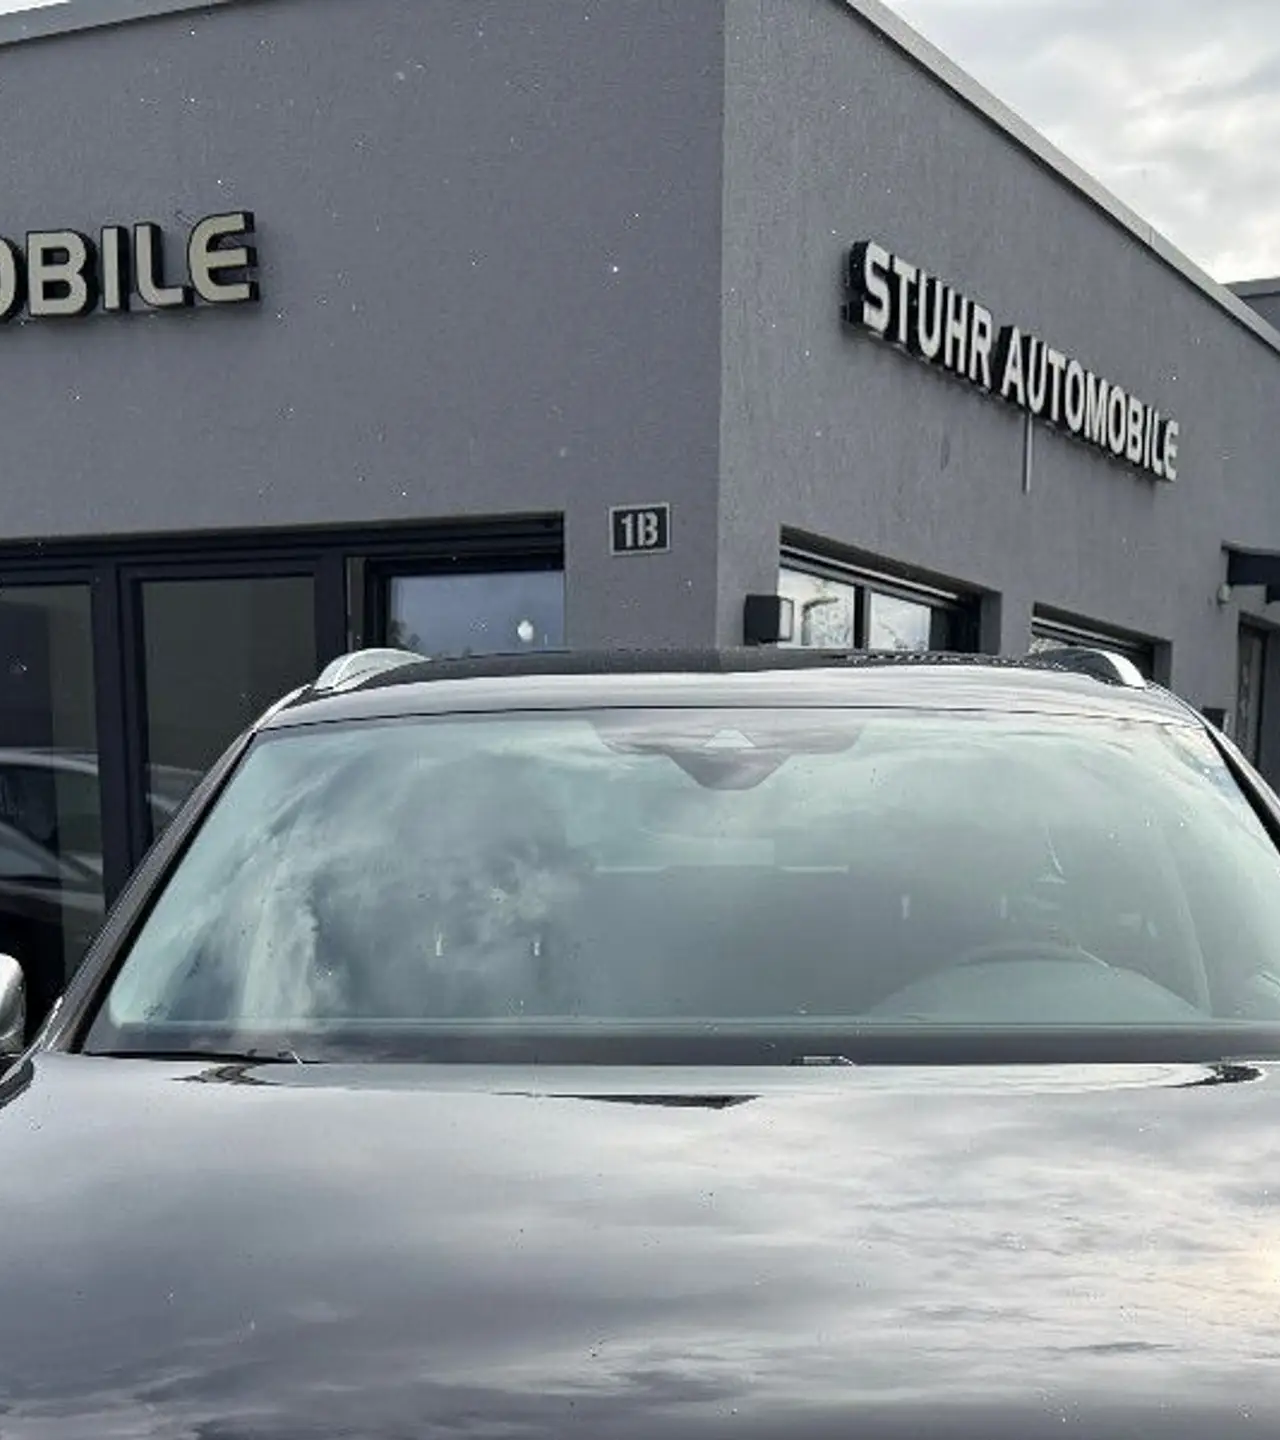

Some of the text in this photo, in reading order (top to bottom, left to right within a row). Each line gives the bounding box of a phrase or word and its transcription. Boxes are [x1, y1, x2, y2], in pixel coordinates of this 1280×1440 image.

[847, 240, 1180, 482] STUHR AUTOMOBILE
[621, 512, 658, 548] 1B
